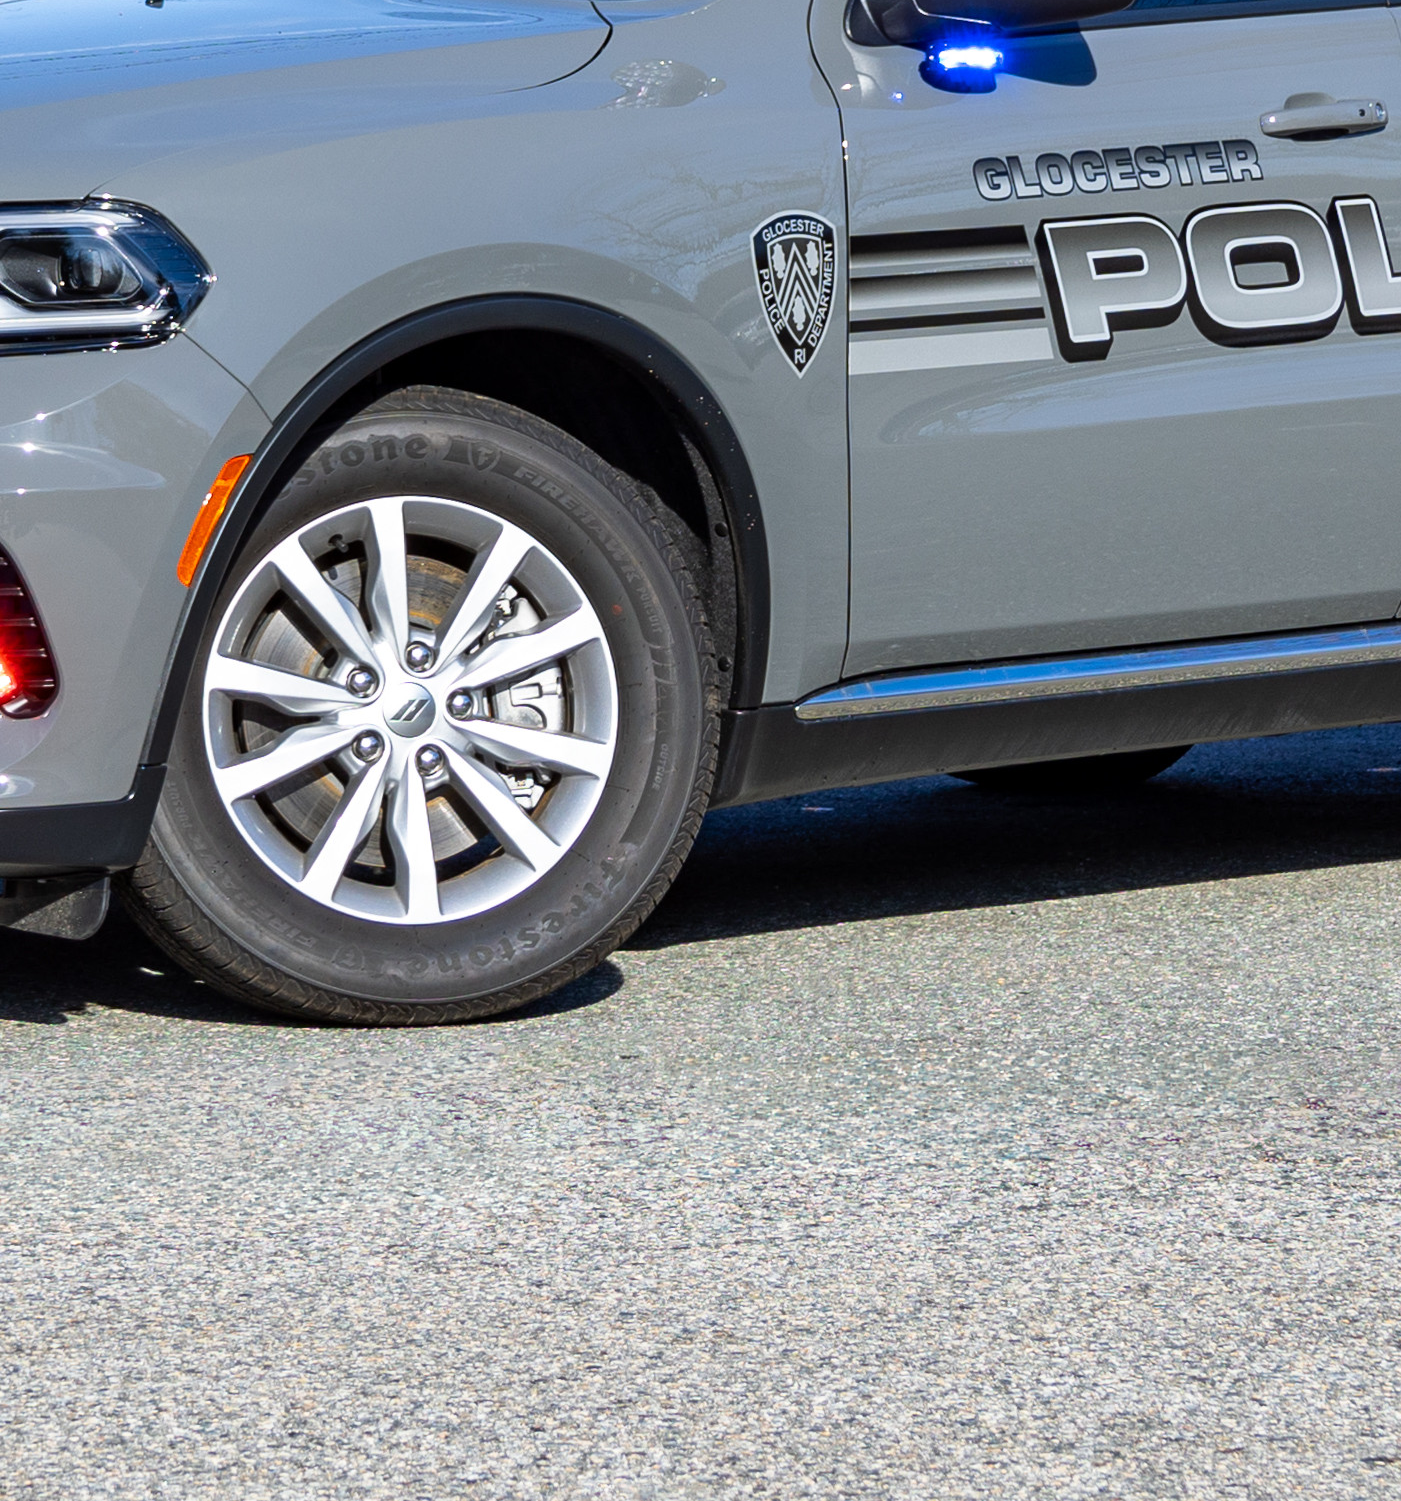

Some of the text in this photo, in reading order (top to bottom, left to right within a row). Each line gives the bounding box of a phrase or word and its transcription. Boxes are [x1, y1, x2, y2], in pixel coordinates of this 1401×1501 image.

[972, 138, 1265, 202] GLOCESTER
[762, 218, 825, 243] GLOCESTER
[759, 268, 786, 335] POLICE
[807, 239, 834, 348] DEPARTMENT
[794, 348, 806, 364] RI
